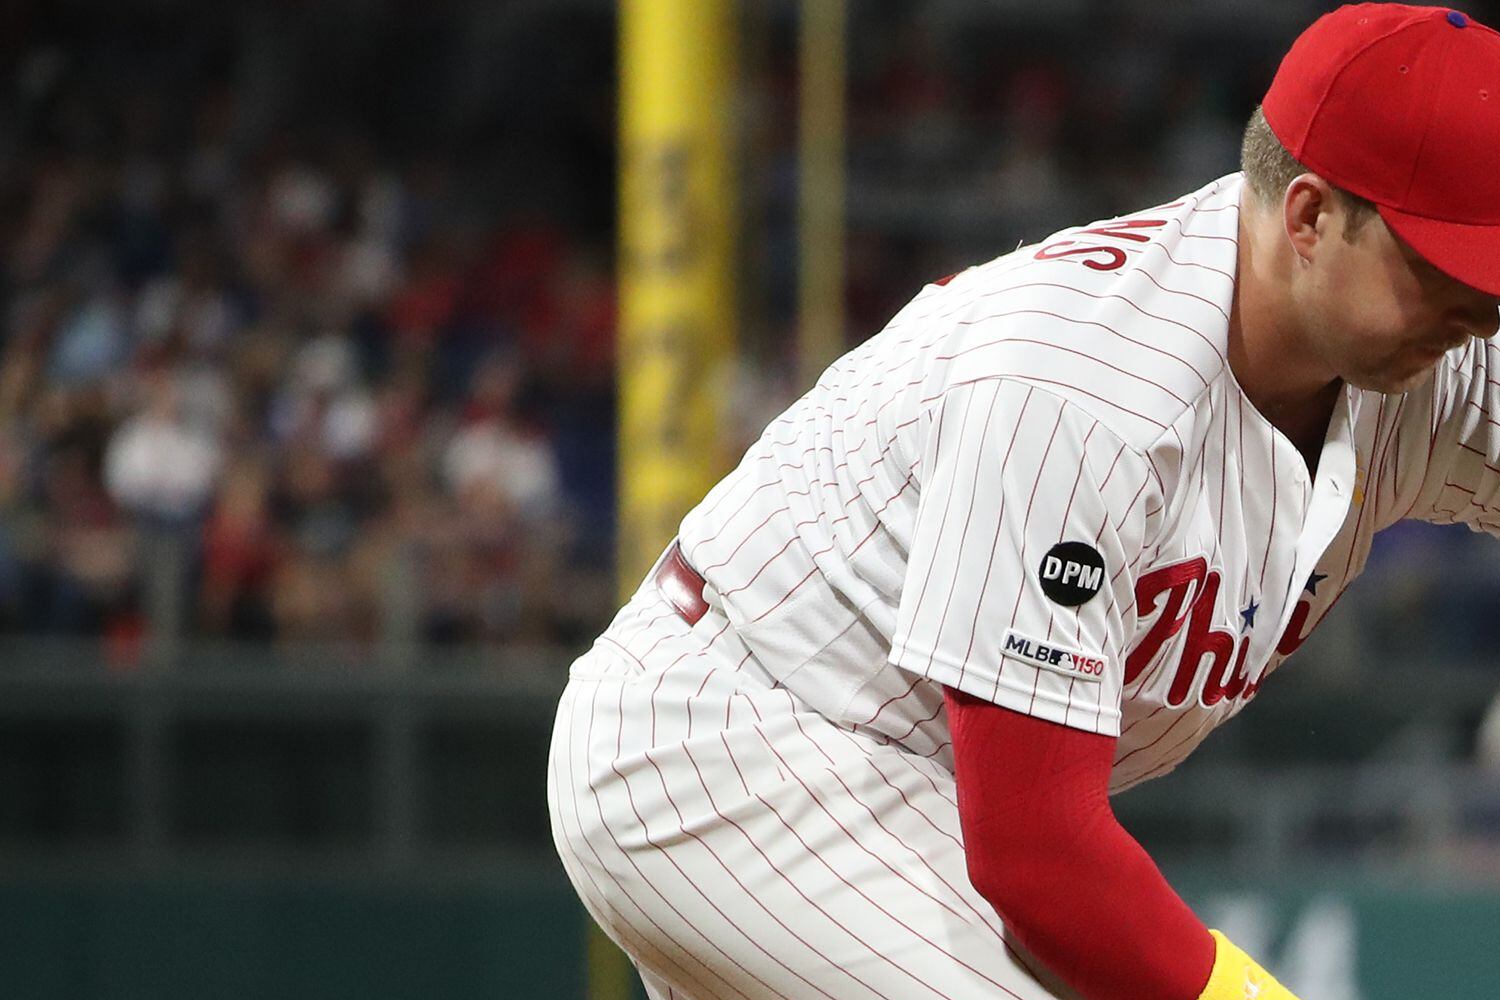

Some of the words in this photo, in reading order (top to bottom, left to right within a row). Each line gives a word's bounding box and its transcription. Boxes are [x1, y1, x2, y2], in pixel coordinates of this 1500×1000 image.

[1042, 555, 1103, 591] DPM
[1004, 634, 1051, 663] MLB
[1078, 657, 1105, 677] 150
